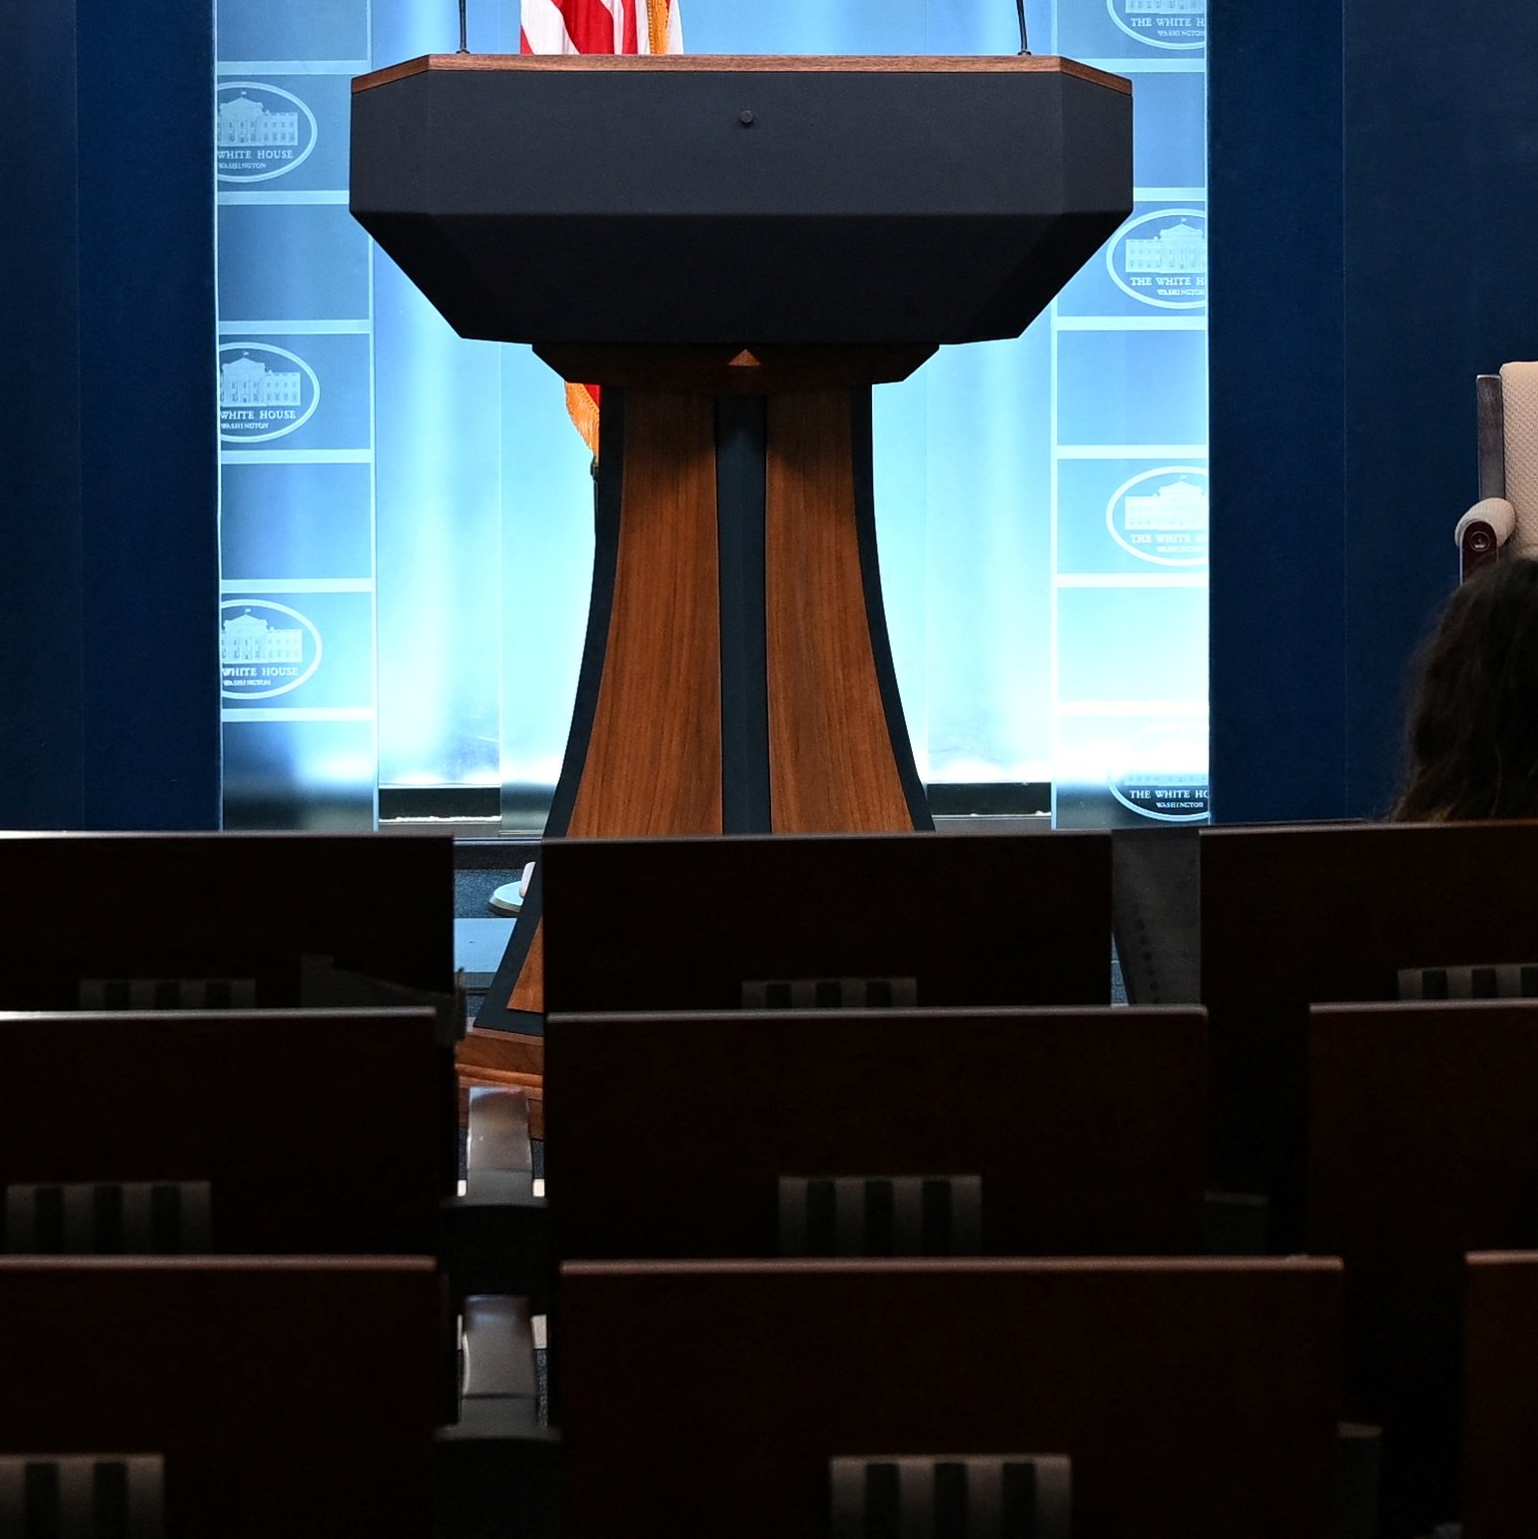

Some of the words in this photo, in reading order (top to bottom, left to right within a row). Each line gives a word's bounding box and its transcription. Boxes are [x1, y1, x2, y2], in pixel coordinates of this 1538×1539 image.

[1130, 17, 1153, 27] THE
[1156, 17, 1192, 27] WHITE
[257, 150, 294, 159] HOUSE
[1129, 276, 1153, 286] THE
[1155, 276, 1192, 286] WHITE
[221, 410, 255, 420] WHITE
[259, 410, 297, 419] HOUSE
[223, 667, 258, 677] WHITE
[262, 667, 300, 676] HOUSE
[1129, 789, 1152, 799] THE
[1155, 789, 1191, 799] WHITE
[1156, 801, 1204, 809] WASHINGTON
